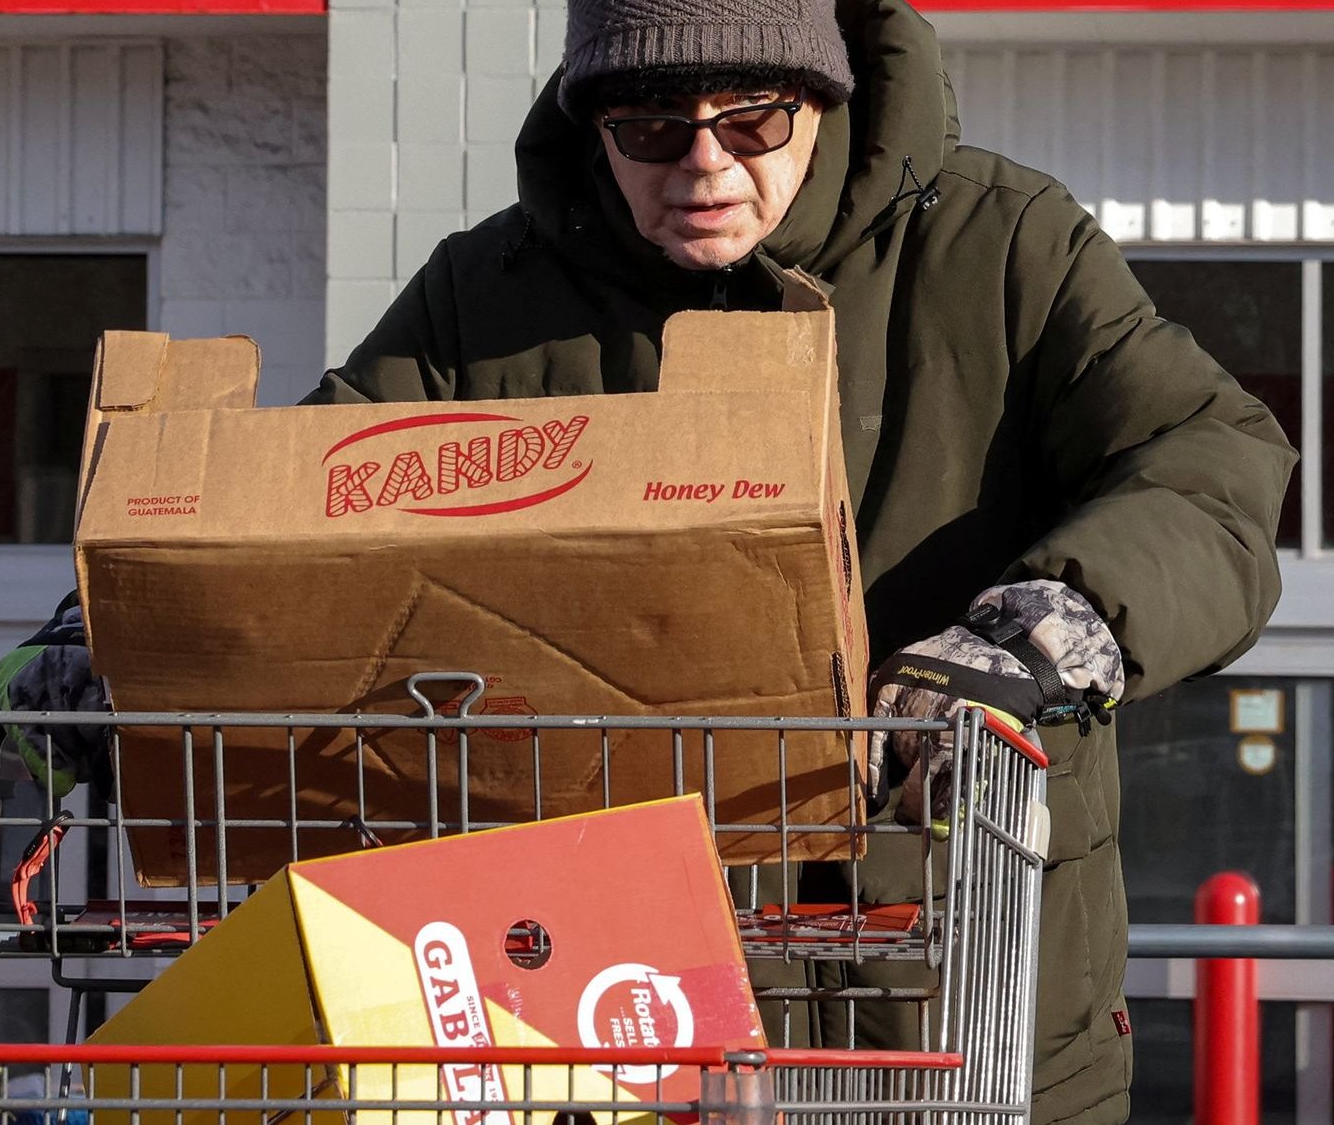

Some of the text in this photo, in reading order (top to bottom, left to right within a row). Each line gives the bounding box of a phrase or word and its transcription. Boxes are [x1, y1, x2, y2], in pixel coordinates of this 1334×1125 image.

[326, 415, 589, 517] KANDY
[127, 495, 200, 506] PRODUCT OF
[643, 479, 785, 503] Honey Dew
[128, 506, 196, 516] GUATEMALA
[467, 995, 481, 1030] SINCE
[631, 988, 660, 1047] Rotat
[610, 1018, 625, 1047] FRES
